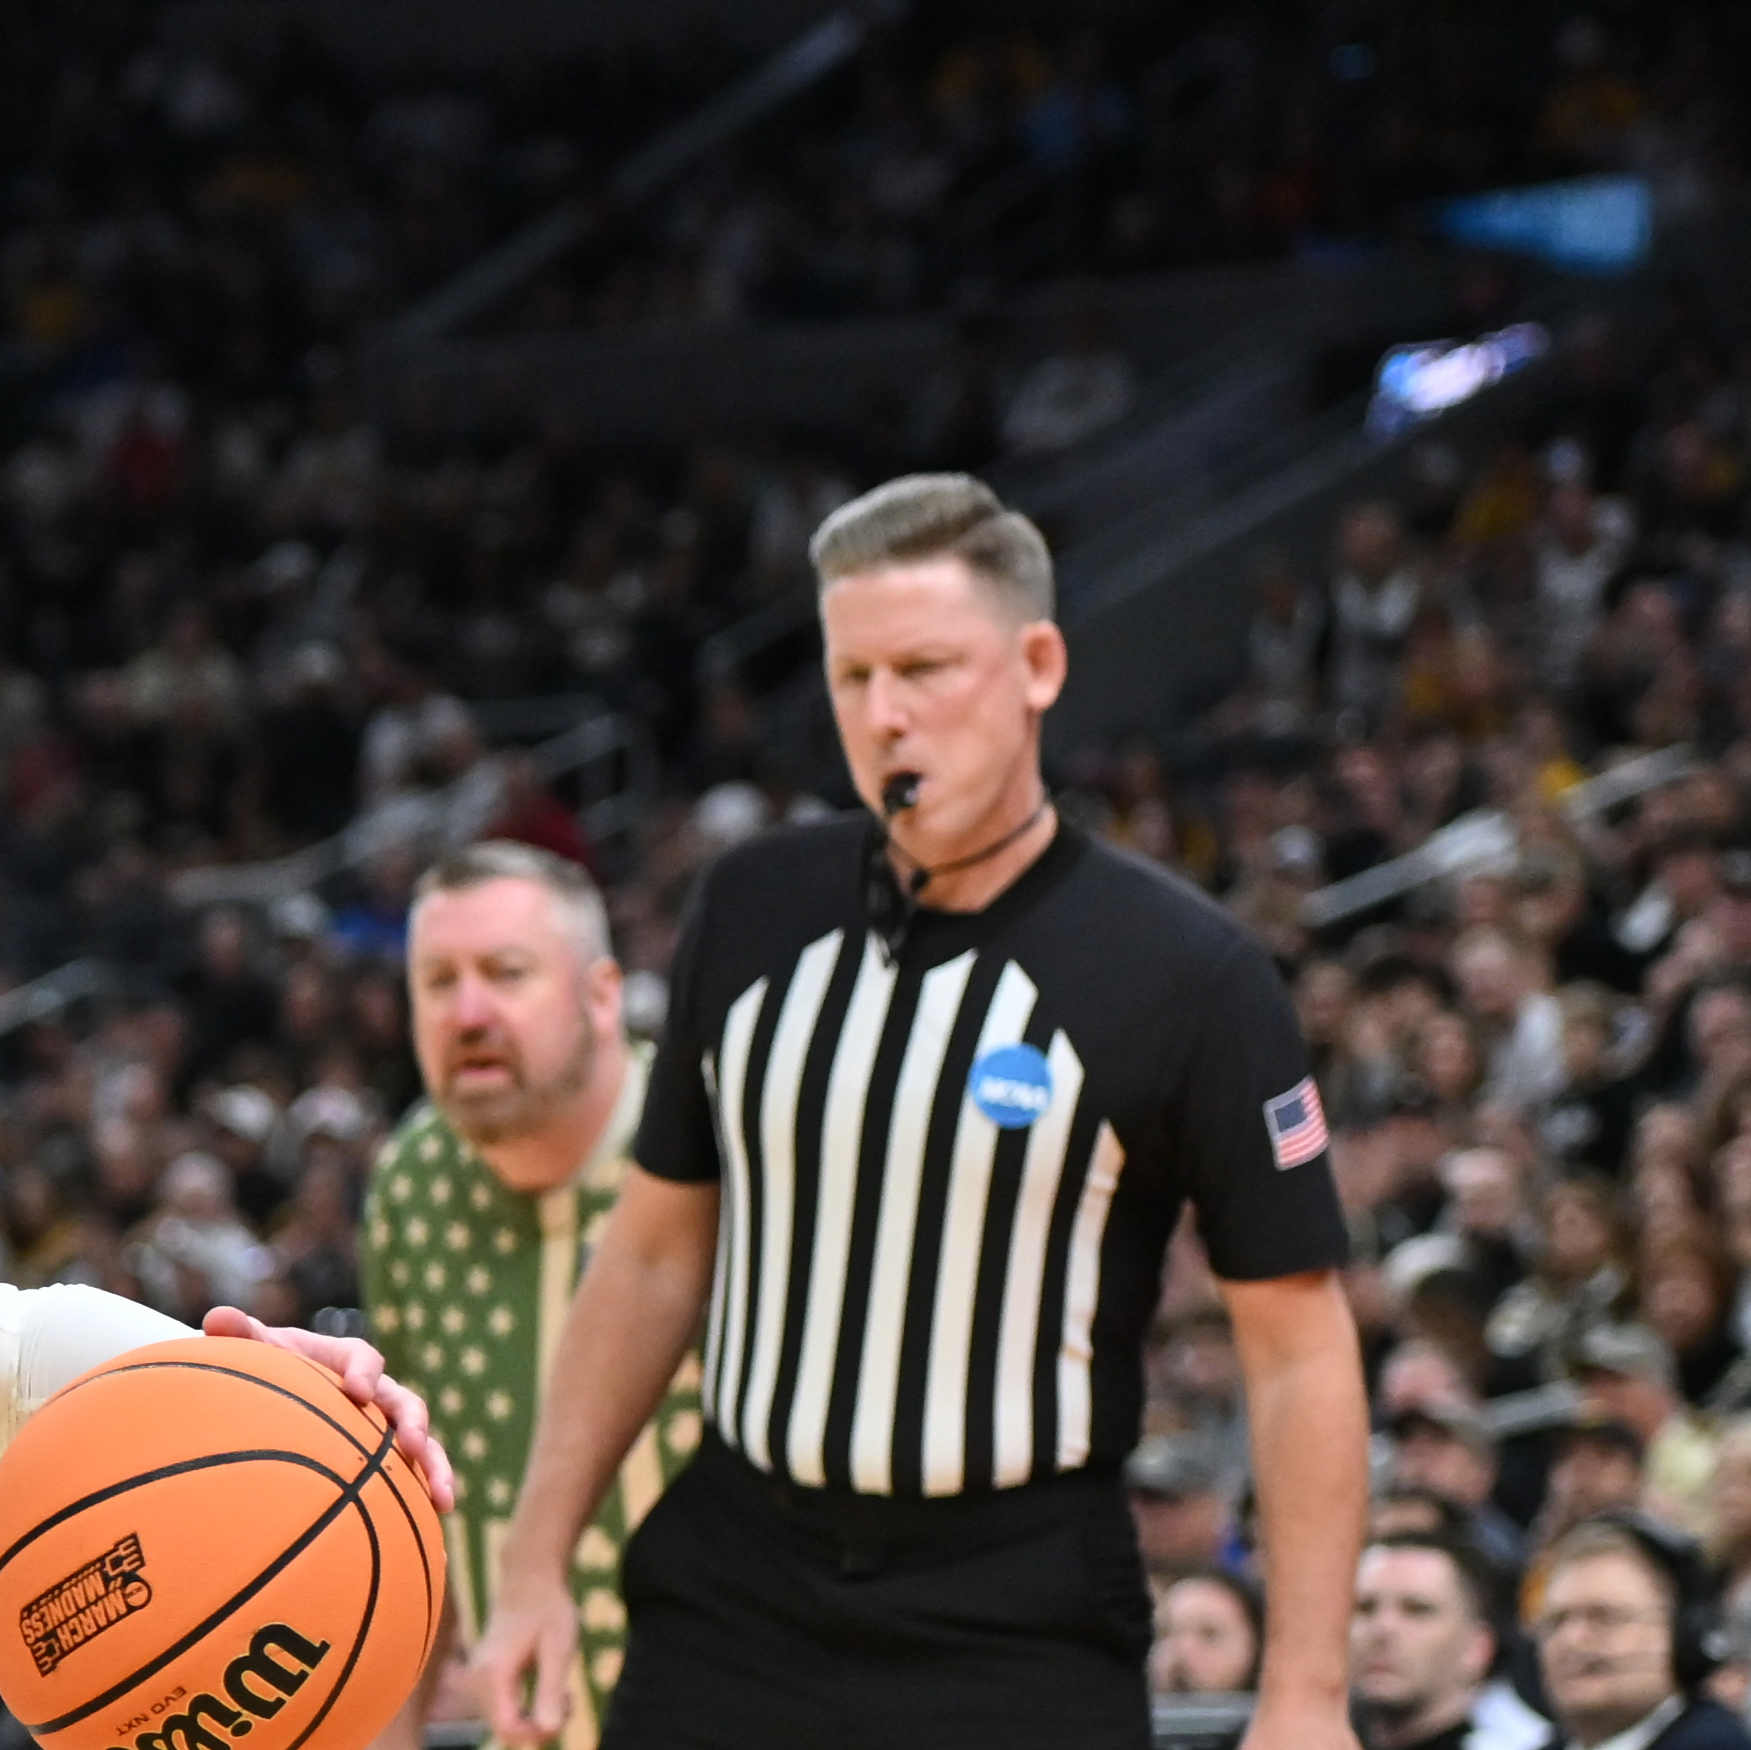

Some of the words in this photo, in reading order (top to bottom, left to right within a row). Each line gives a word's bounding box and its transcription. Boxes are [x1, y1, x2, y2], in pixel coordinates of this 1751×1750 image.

[20, 1570, 107, 1645] MADNESS
[55, 1588, 128, 1652] MARCH
[149, 1685, 188, 1715] EVO
[115, 1711, 150, 1737] NXT
